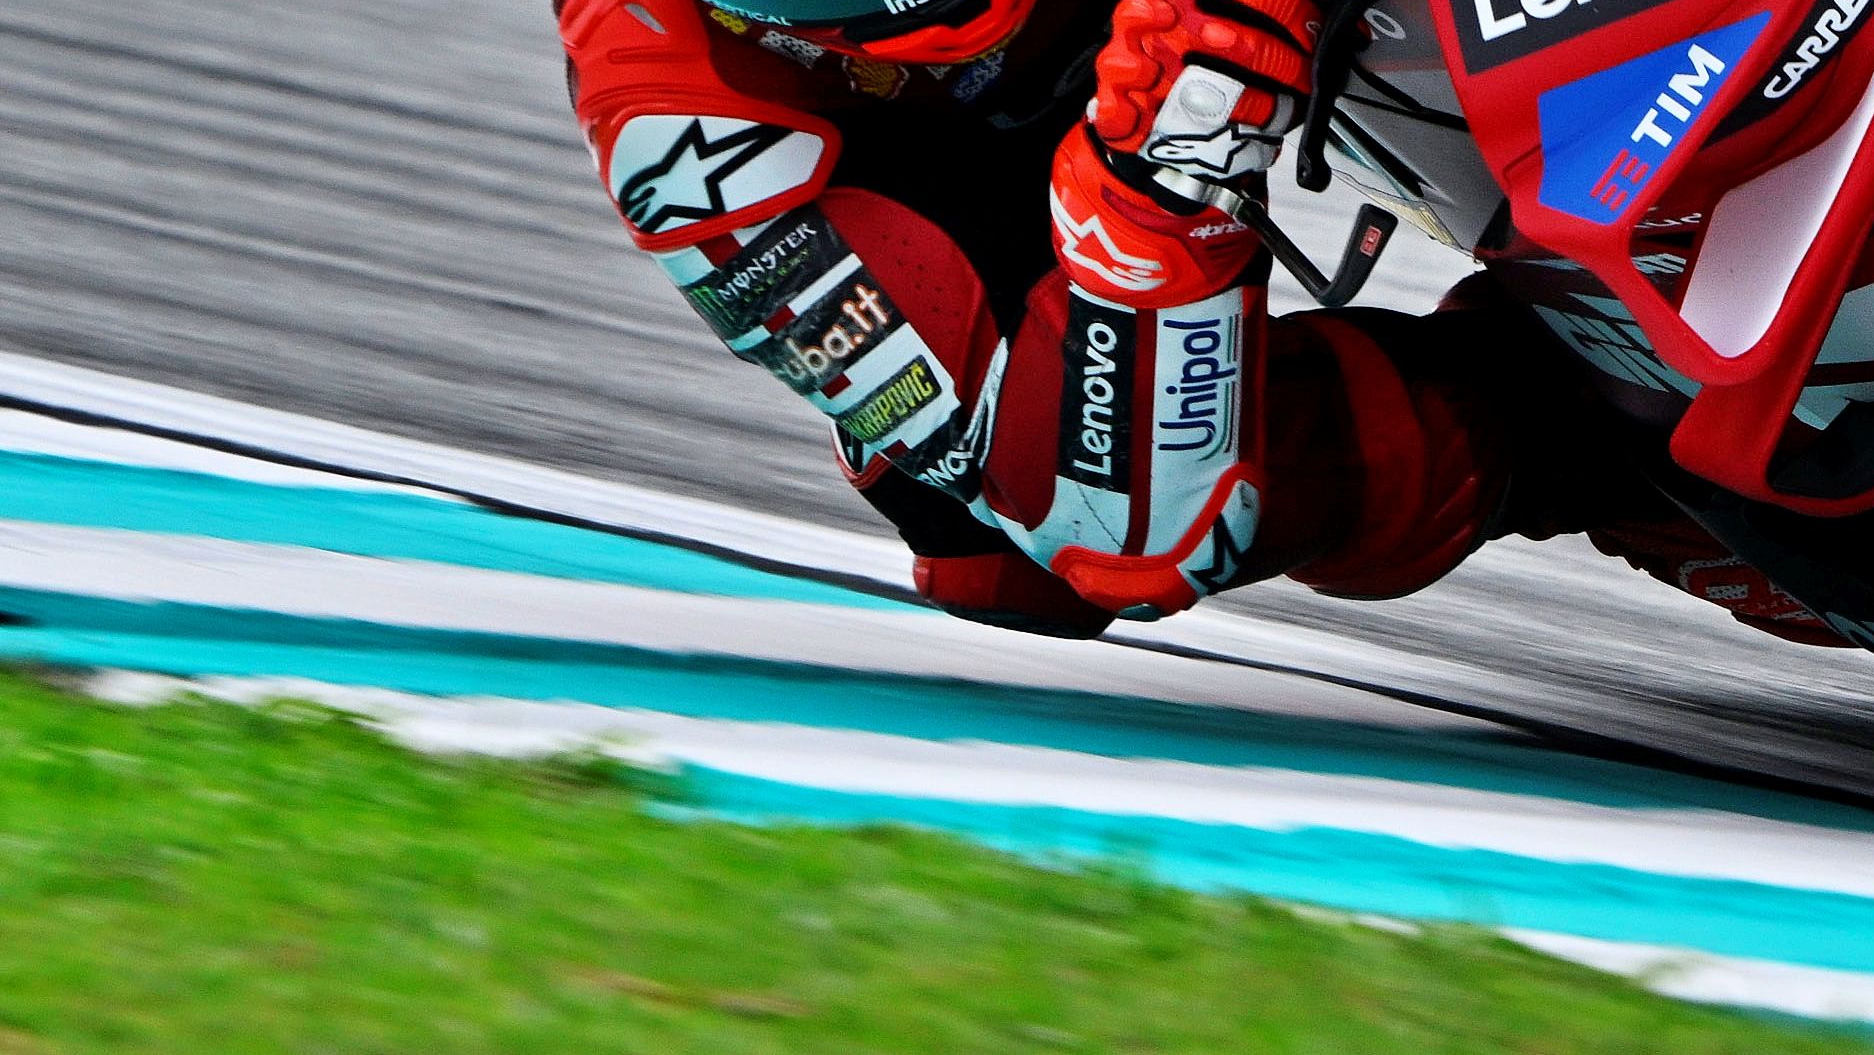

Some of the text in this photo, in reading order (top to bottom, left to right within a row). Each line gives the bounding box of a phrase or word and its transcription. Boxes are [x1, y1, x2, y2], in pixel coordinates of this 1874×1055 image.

[1630, 43, 1727, 148] TIM
[1072, 322, 1118, 476] Lenovo
[1158, 318, 1236, 451] Unipol
